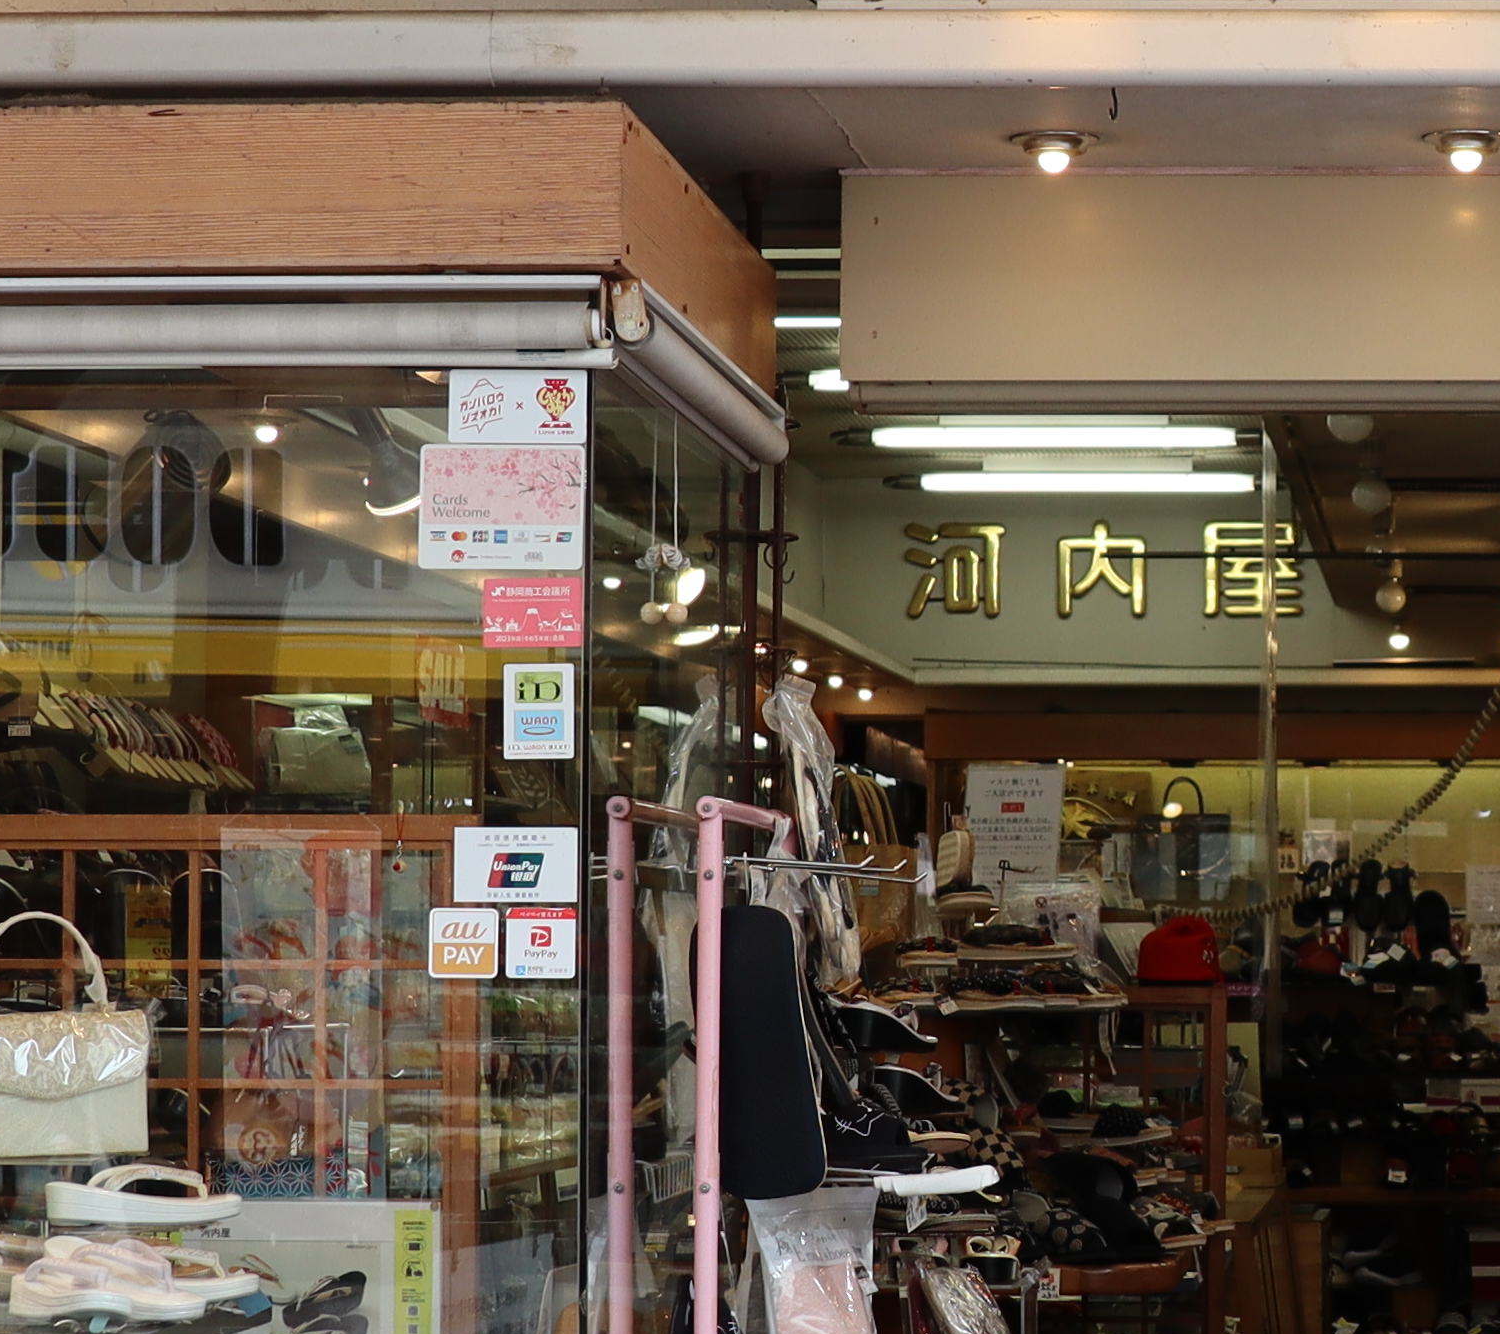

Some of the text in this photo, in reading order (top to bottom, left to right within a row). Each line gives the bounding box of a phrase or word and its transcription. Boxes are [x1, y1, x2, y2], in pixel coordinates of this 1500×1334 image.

[432, 493, 468, 505] Cards
[432, 506, 491, 518] Welcome
[904, 520, 1304, 619] 河内屋
[518, 680, 561, 701] iD
[521, 716, 558, 725] WAON
[493, 860, 541, 874] UnionPay
[441, 921, 488, 940] au
[443, 946, 485, 965] PAY
[524, 949, 558, 960] PayPay
